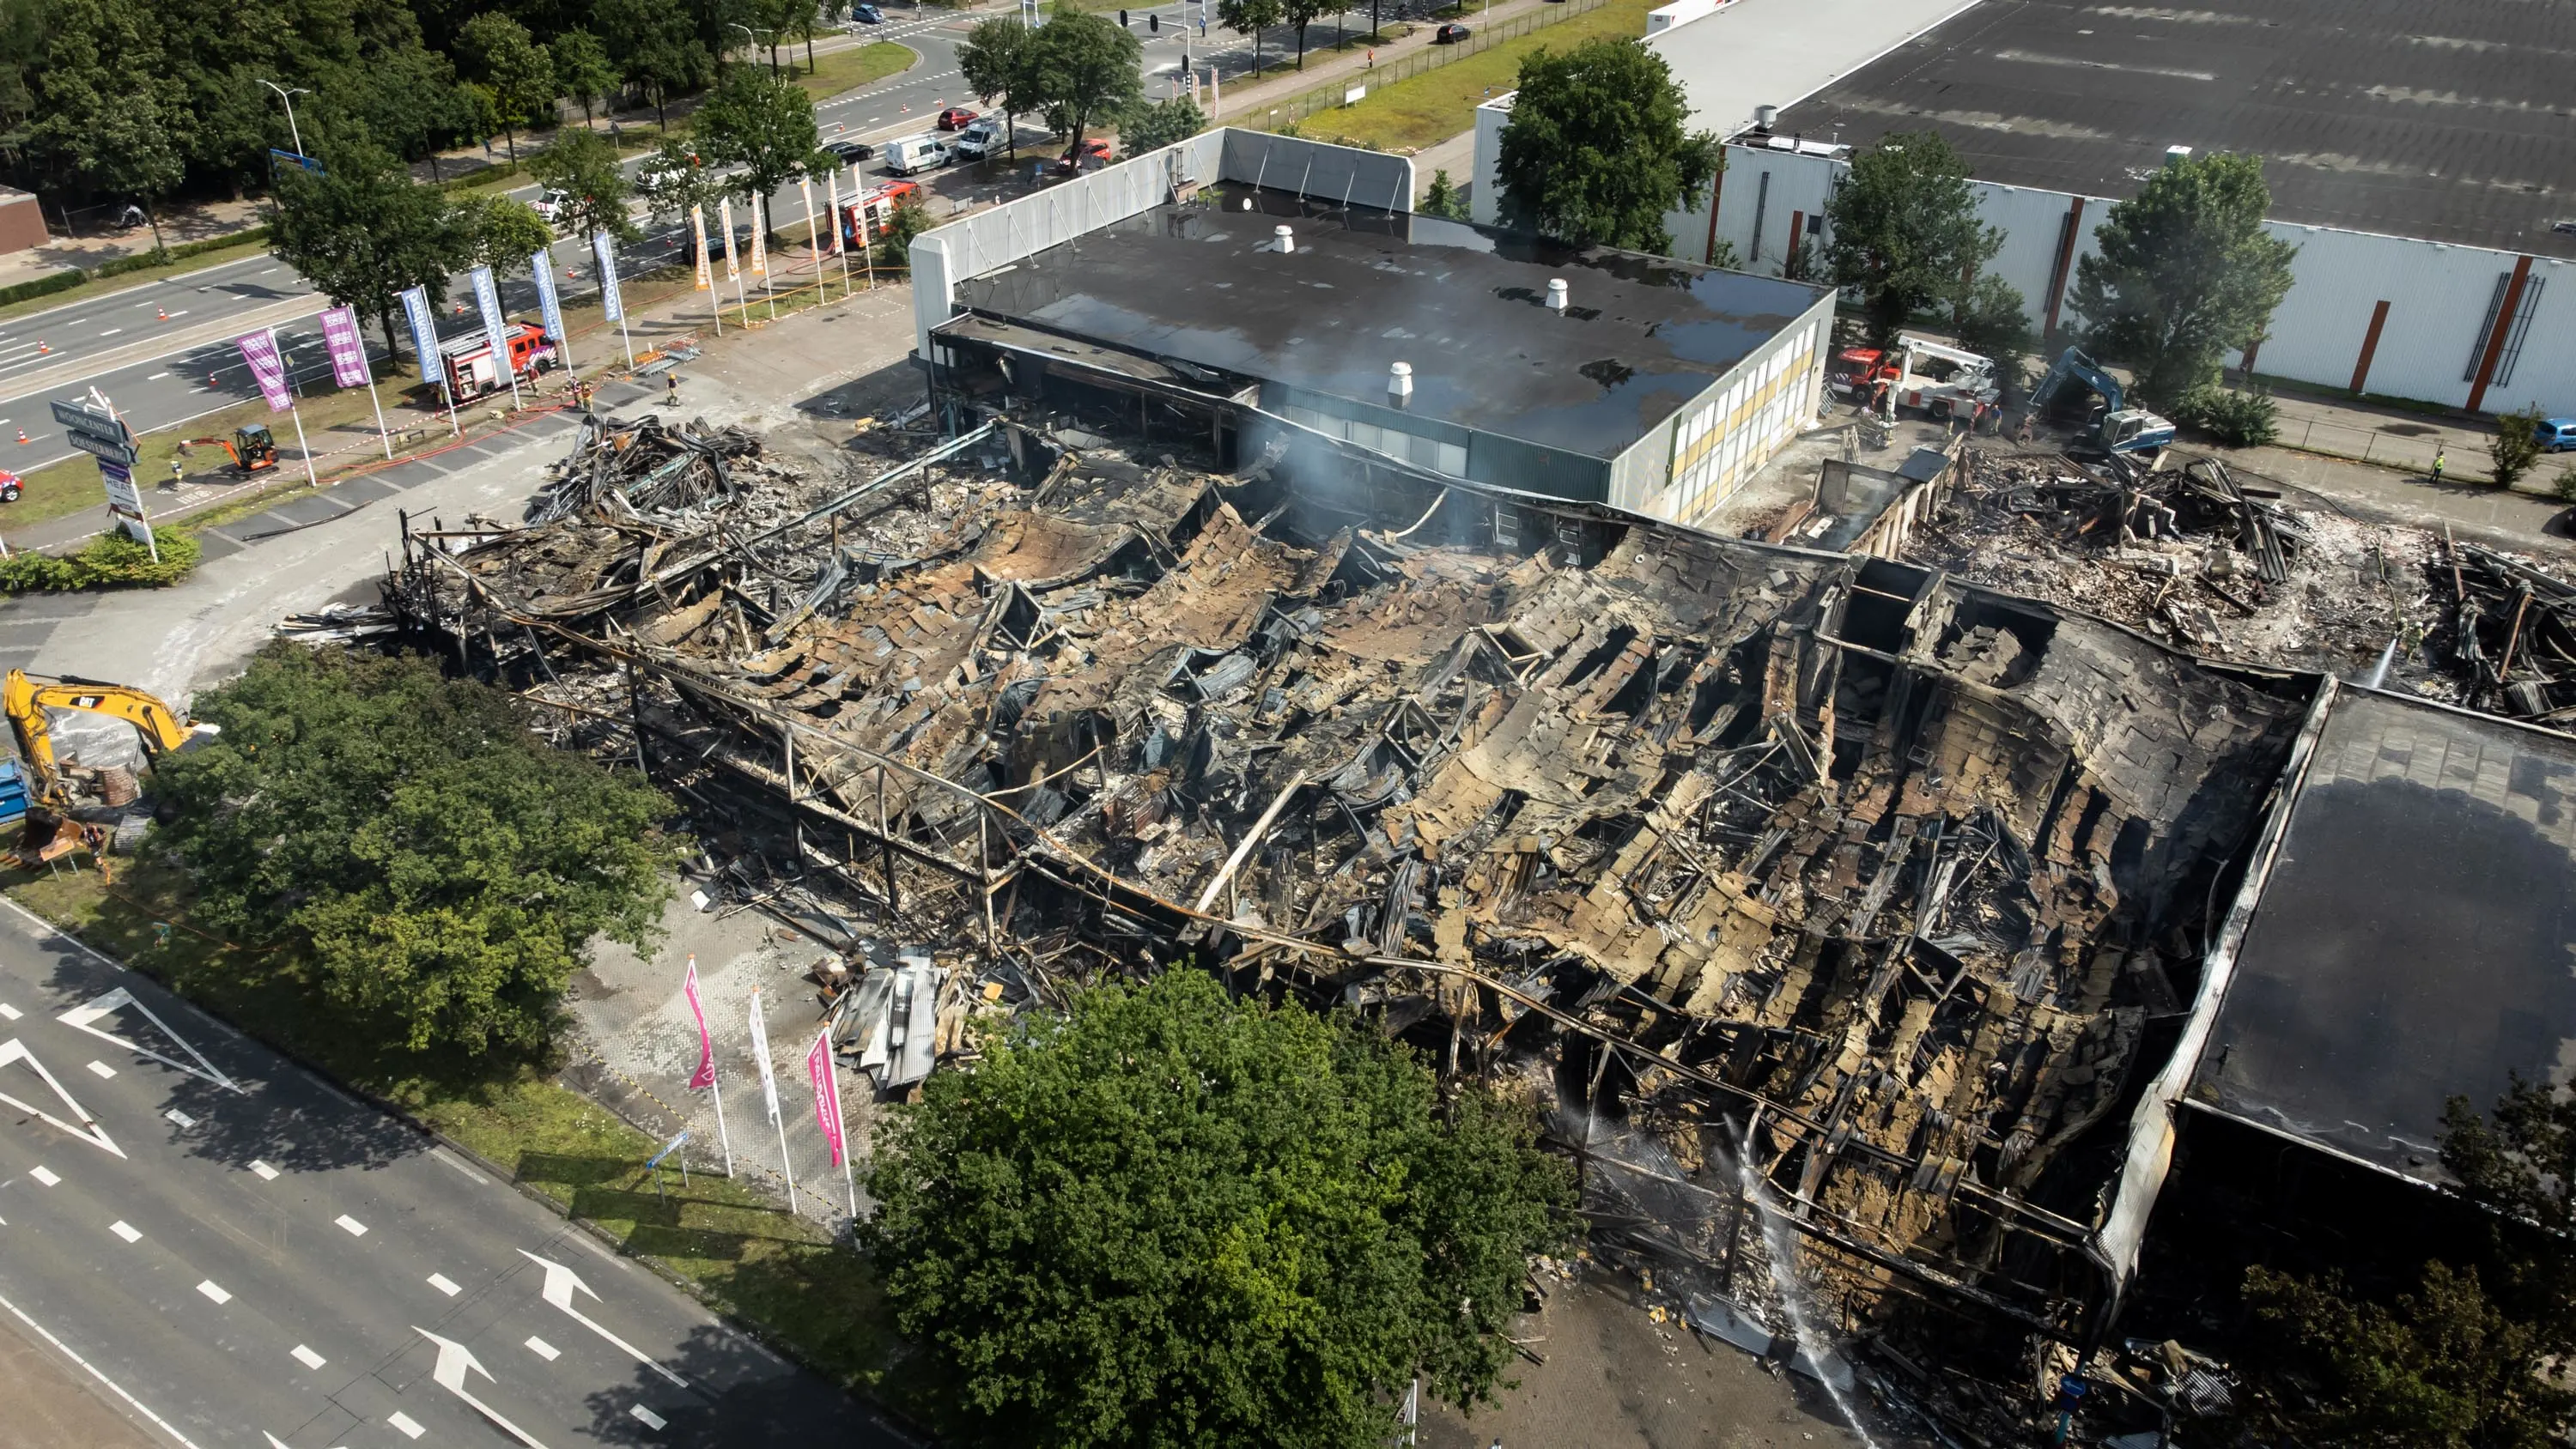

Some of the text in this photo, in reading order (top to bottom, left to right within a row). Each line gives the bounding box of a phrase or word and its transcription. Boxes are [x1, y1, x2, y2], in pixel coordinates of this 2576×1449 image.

[57, 410, 116, 435] WOONCENTER
[70, 435, 126, 462] SOESTERBERG
[106, 480, 131, 494] HEAT
